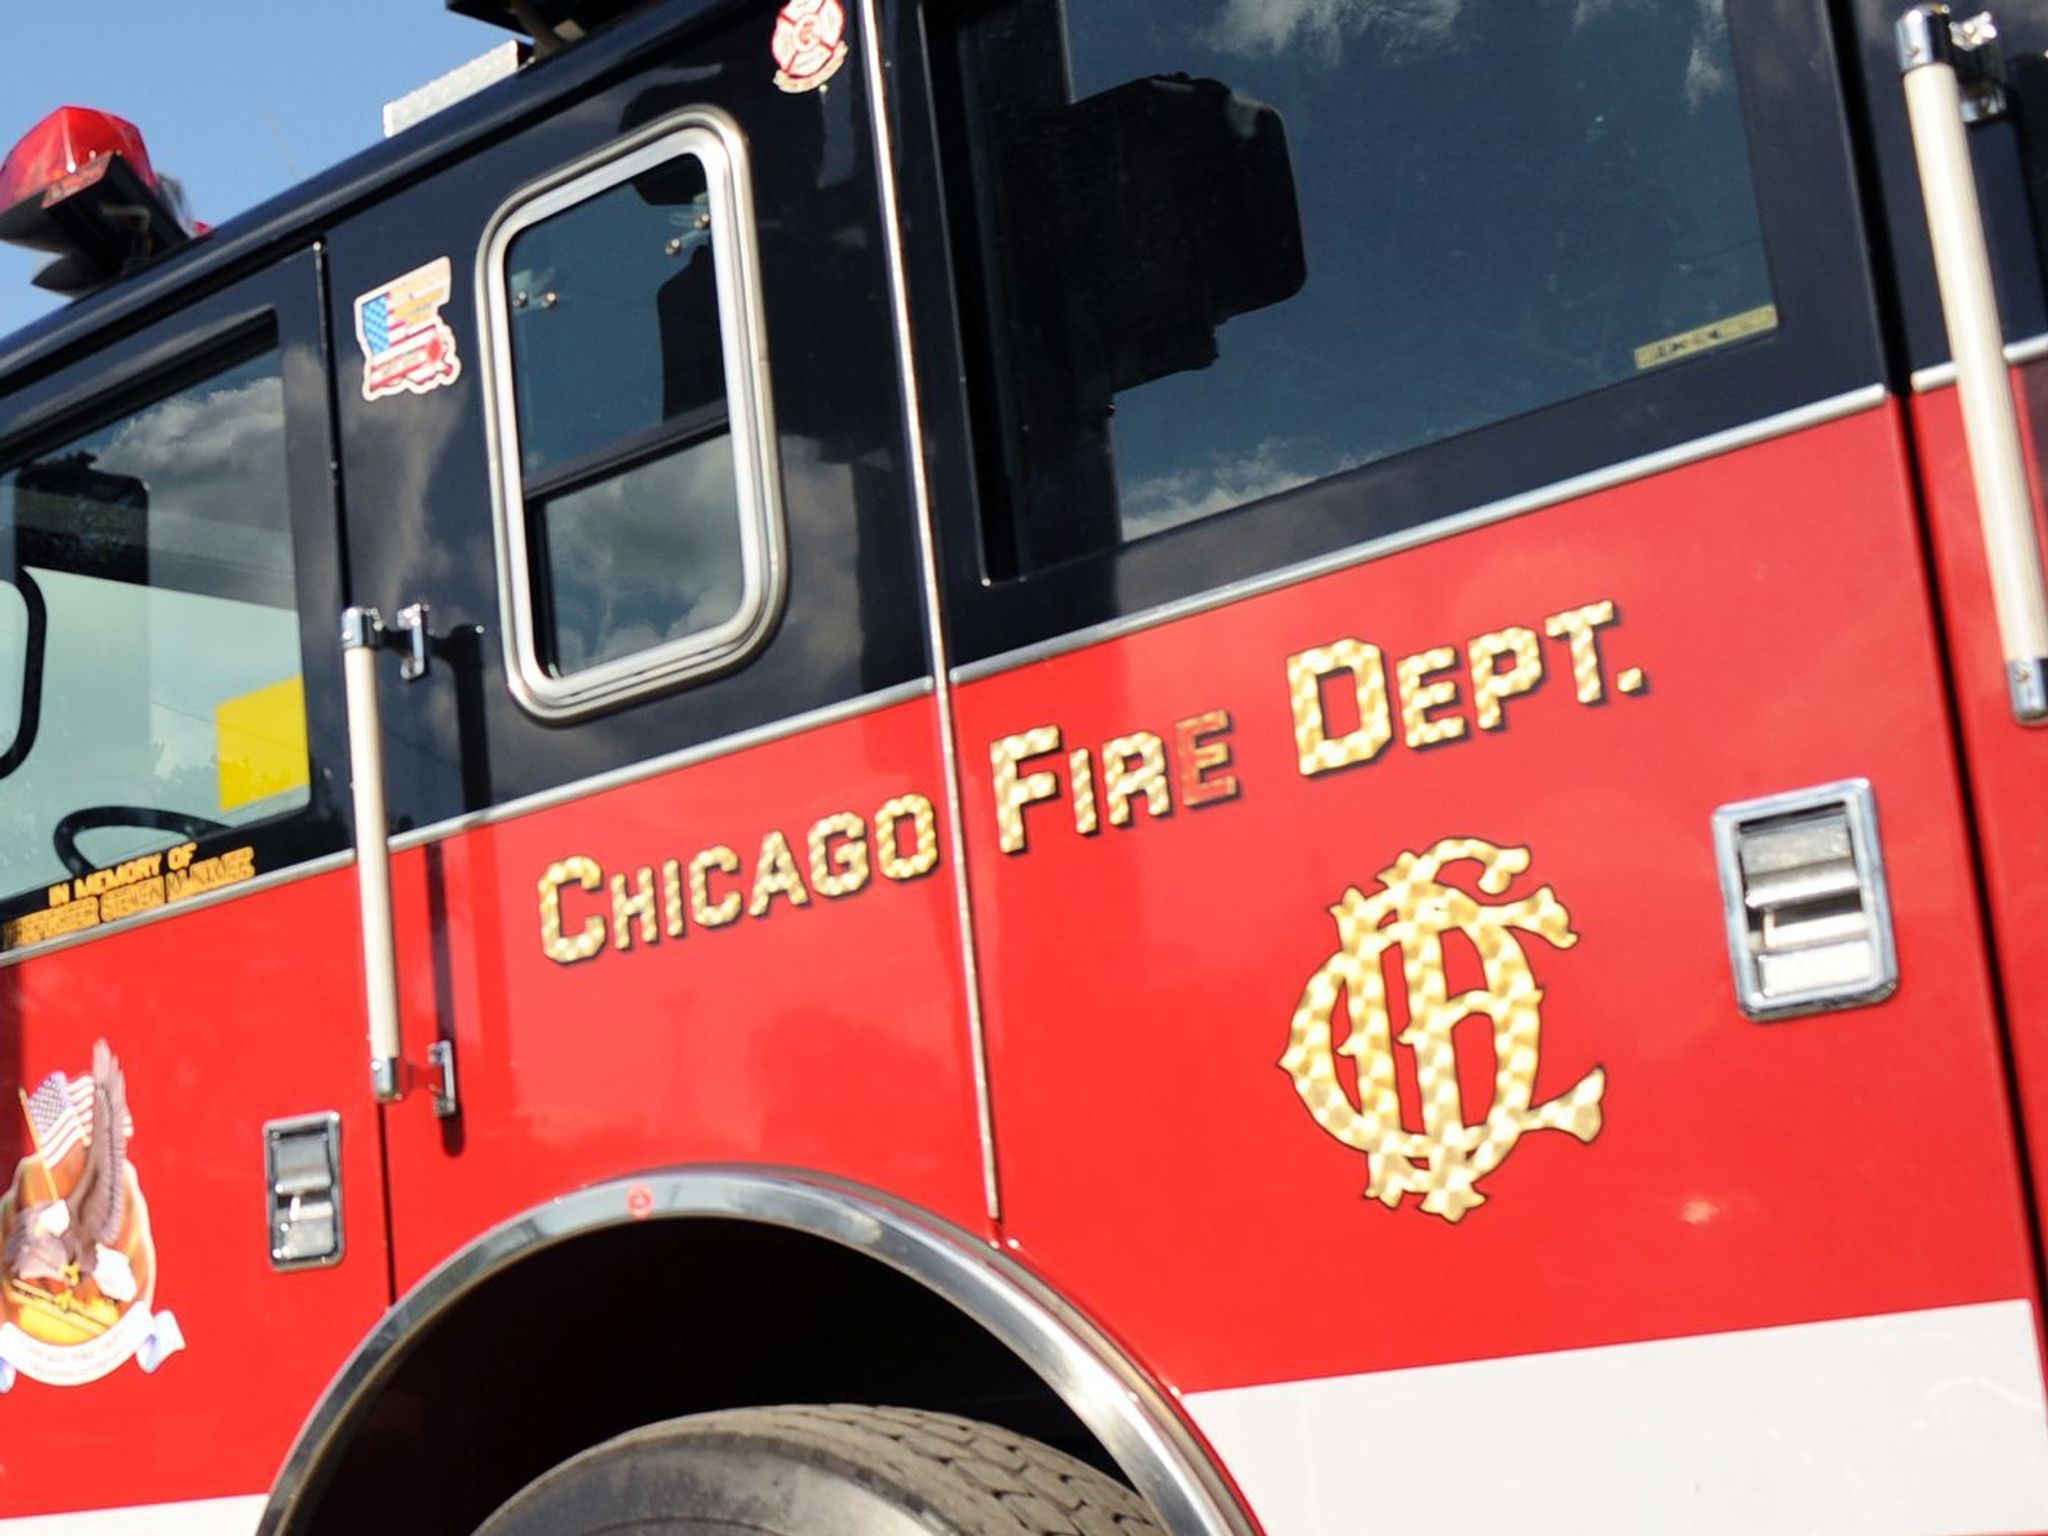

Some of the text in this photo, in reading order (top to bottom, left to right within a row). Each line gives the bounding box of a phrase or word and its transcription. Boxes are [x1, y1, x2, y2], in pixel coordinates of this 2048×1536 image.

[48, 883, 70, 908] IN
[74, 853, 163, 899] MEMORY
[167, 841, 198, 871] OF
[537, 599, 1650, 966] CHICAGO FIRE DEPT.
